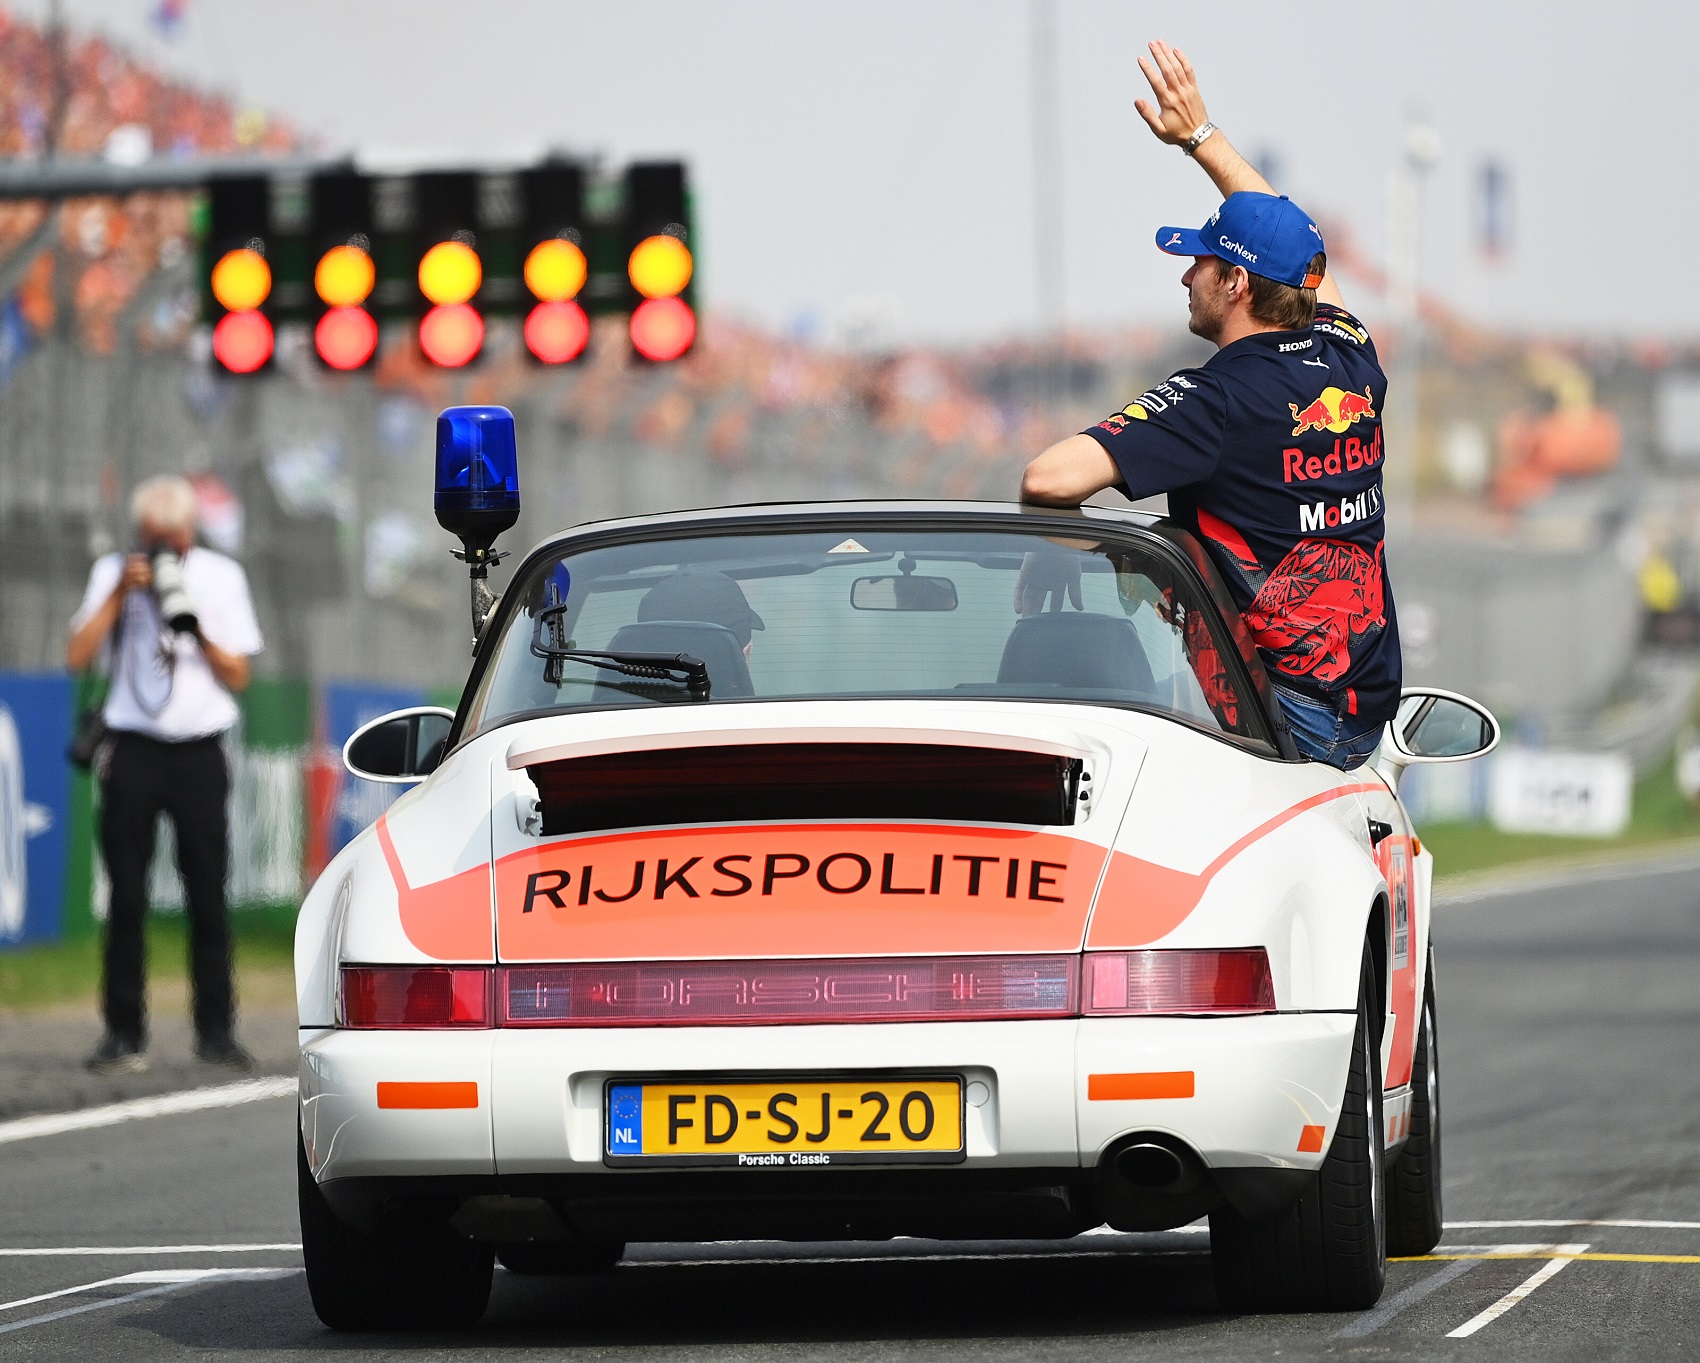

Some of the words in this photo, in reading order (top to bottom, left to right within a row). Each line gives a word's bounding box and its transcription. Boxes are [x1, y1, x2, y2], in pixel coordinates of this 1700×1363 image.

[1219, 235, 1258, 264] CarNext
[1278, 338, 1313, 353] HOND
[1282, 438, 1342, 483] Red
[1345, 424, 1381, 472] Bull
[1299, 491, 1367, 533] Mobil
[521, 852, 1068, 915] RIJKSPOLITIE
[535, 971, 1038, 1009] PORSCHE
[615, 1127, 638, 1144] NL
[668, 1090, 935, 1145] FD-SJ-20
[738, 1153, 785, 1166] Porsche
[789, 1152, 831, 1165] Classic
